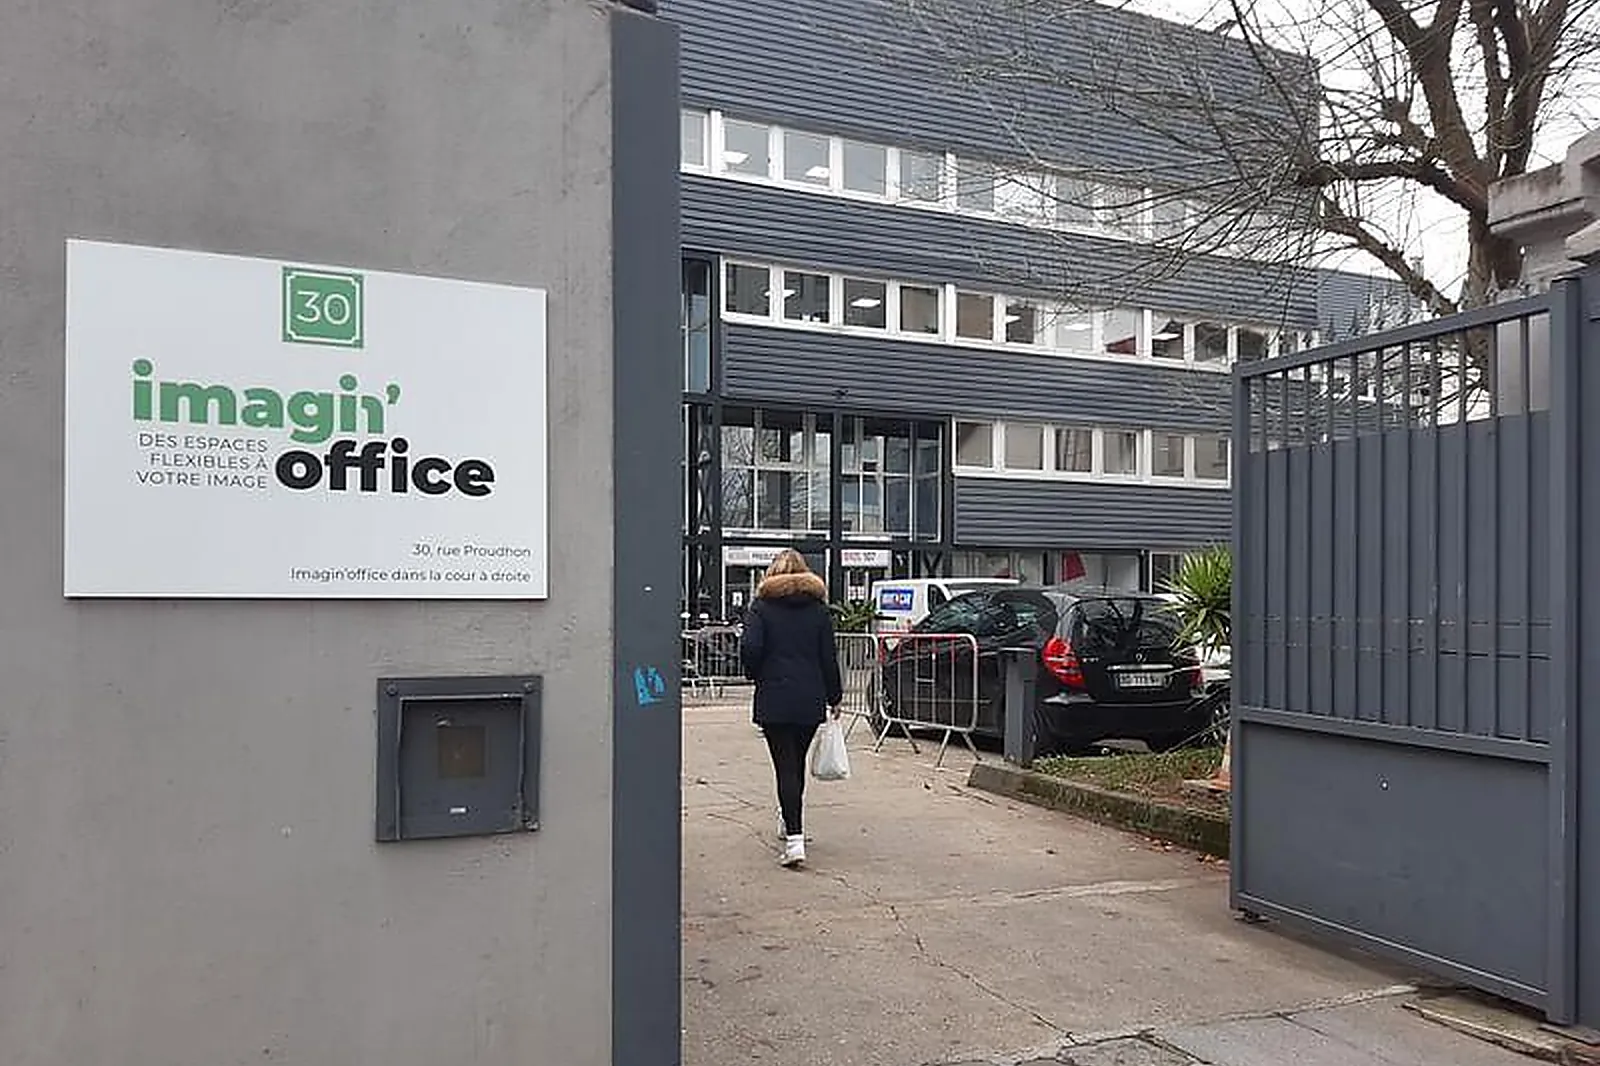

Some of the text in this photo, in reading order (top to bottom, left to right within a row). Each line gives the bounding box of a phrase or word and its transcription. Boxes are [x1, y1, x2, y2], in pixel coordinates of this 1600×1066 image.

[296, 290, 351, 326] 30
[132, 358, 401, 444] imagin'
[139, 432, 268, 453] DES ESPACES
[150, 453, 268, 470] FLEXIBLES À
[275, 437, 495, 497] office
[136, 471, 267, 489] VOTRE IMAGE
[412, 543, 531, 558] 30, rue Proudhon
[291, 567, 531, 582] Imagin'office dans la cour à droite
